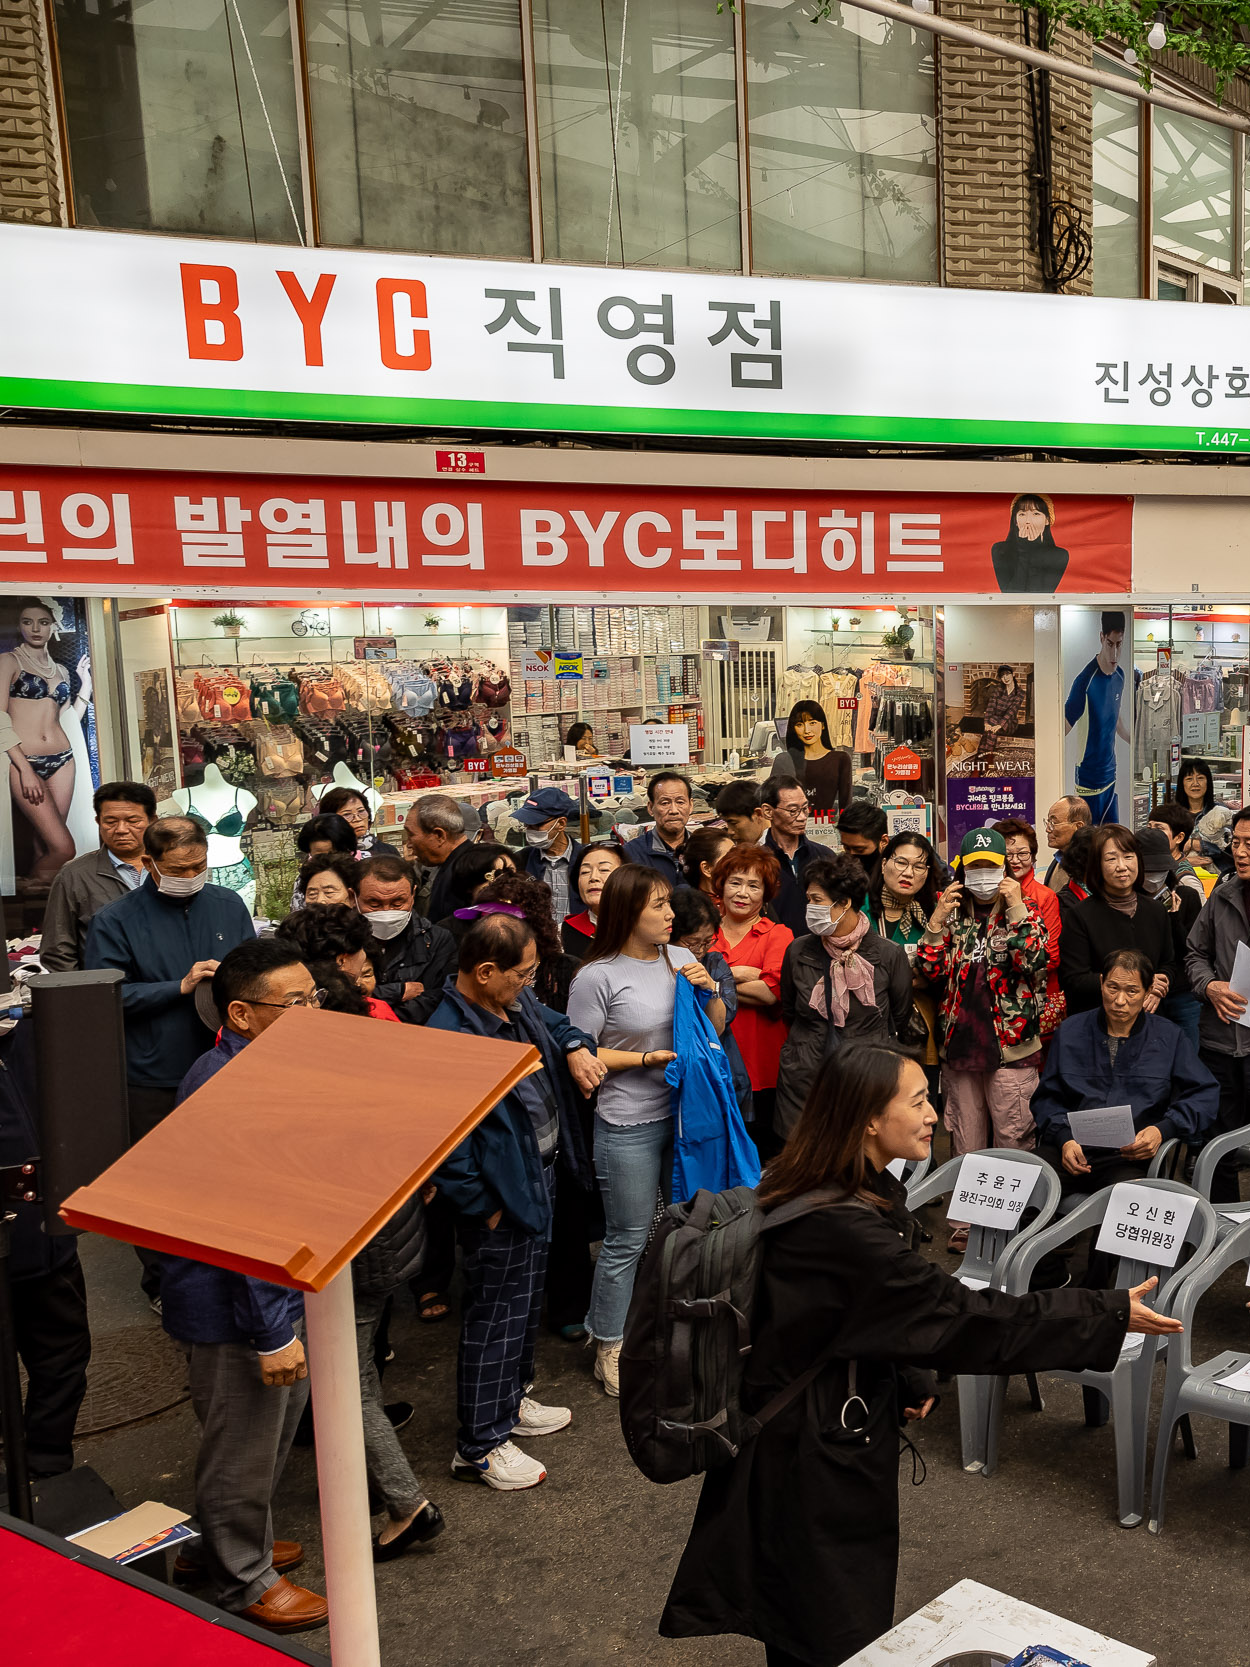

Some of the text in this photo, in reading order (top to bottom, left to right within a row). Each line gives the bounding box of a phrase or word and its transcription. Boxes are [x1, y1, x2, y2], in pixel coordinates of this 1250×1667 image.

[179, 262, 784, 391] BYC 직영점
[448, 452, 467, 467] 13
[174, 495, 486, 571] 발열내의
[520, 507, 945, 575] BYC보디히트
[525, 664, 550, 672] NSOK
[558, 664, 580, 672] NSOK
[839, 699, 856, 708] BYC
[467, 760, 485, 770] BYC
[951, 761, 988, 772] NIGHT
[967, 794, 988, 803] 귀여운
[955, 803, 989, 811] BYC내의로
[959, 1190, 1024, 1213] 광진구의회 의장
[1115, 1222, 1176, 1250] 당협위원장
